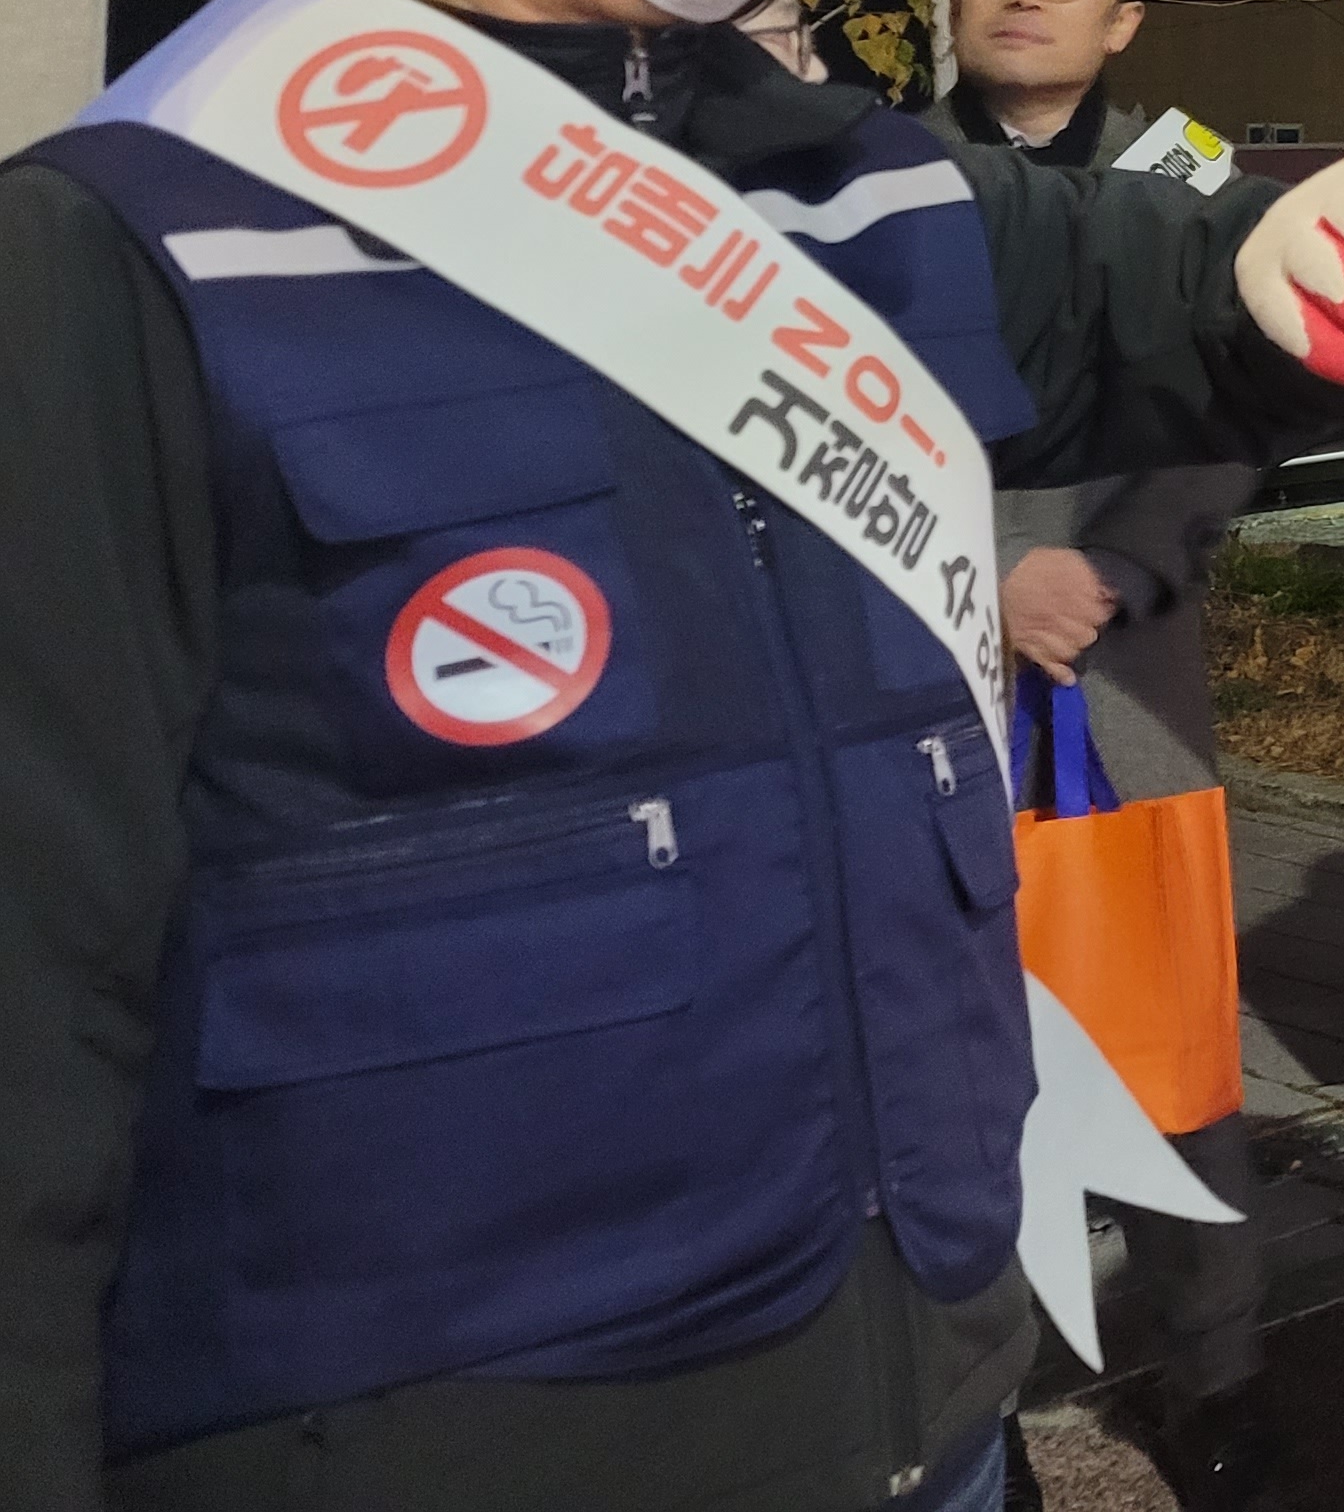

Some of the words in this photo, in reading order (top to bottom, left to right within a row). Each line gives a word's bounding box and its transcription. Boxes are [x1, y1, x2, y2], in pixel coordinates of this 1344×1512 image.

[522, 121, 780, 324] 담배는
[770, 296, 948, 468] NO!
[728, 369, 938, 571] 거절할
[938, 554, 978, 630] 수
